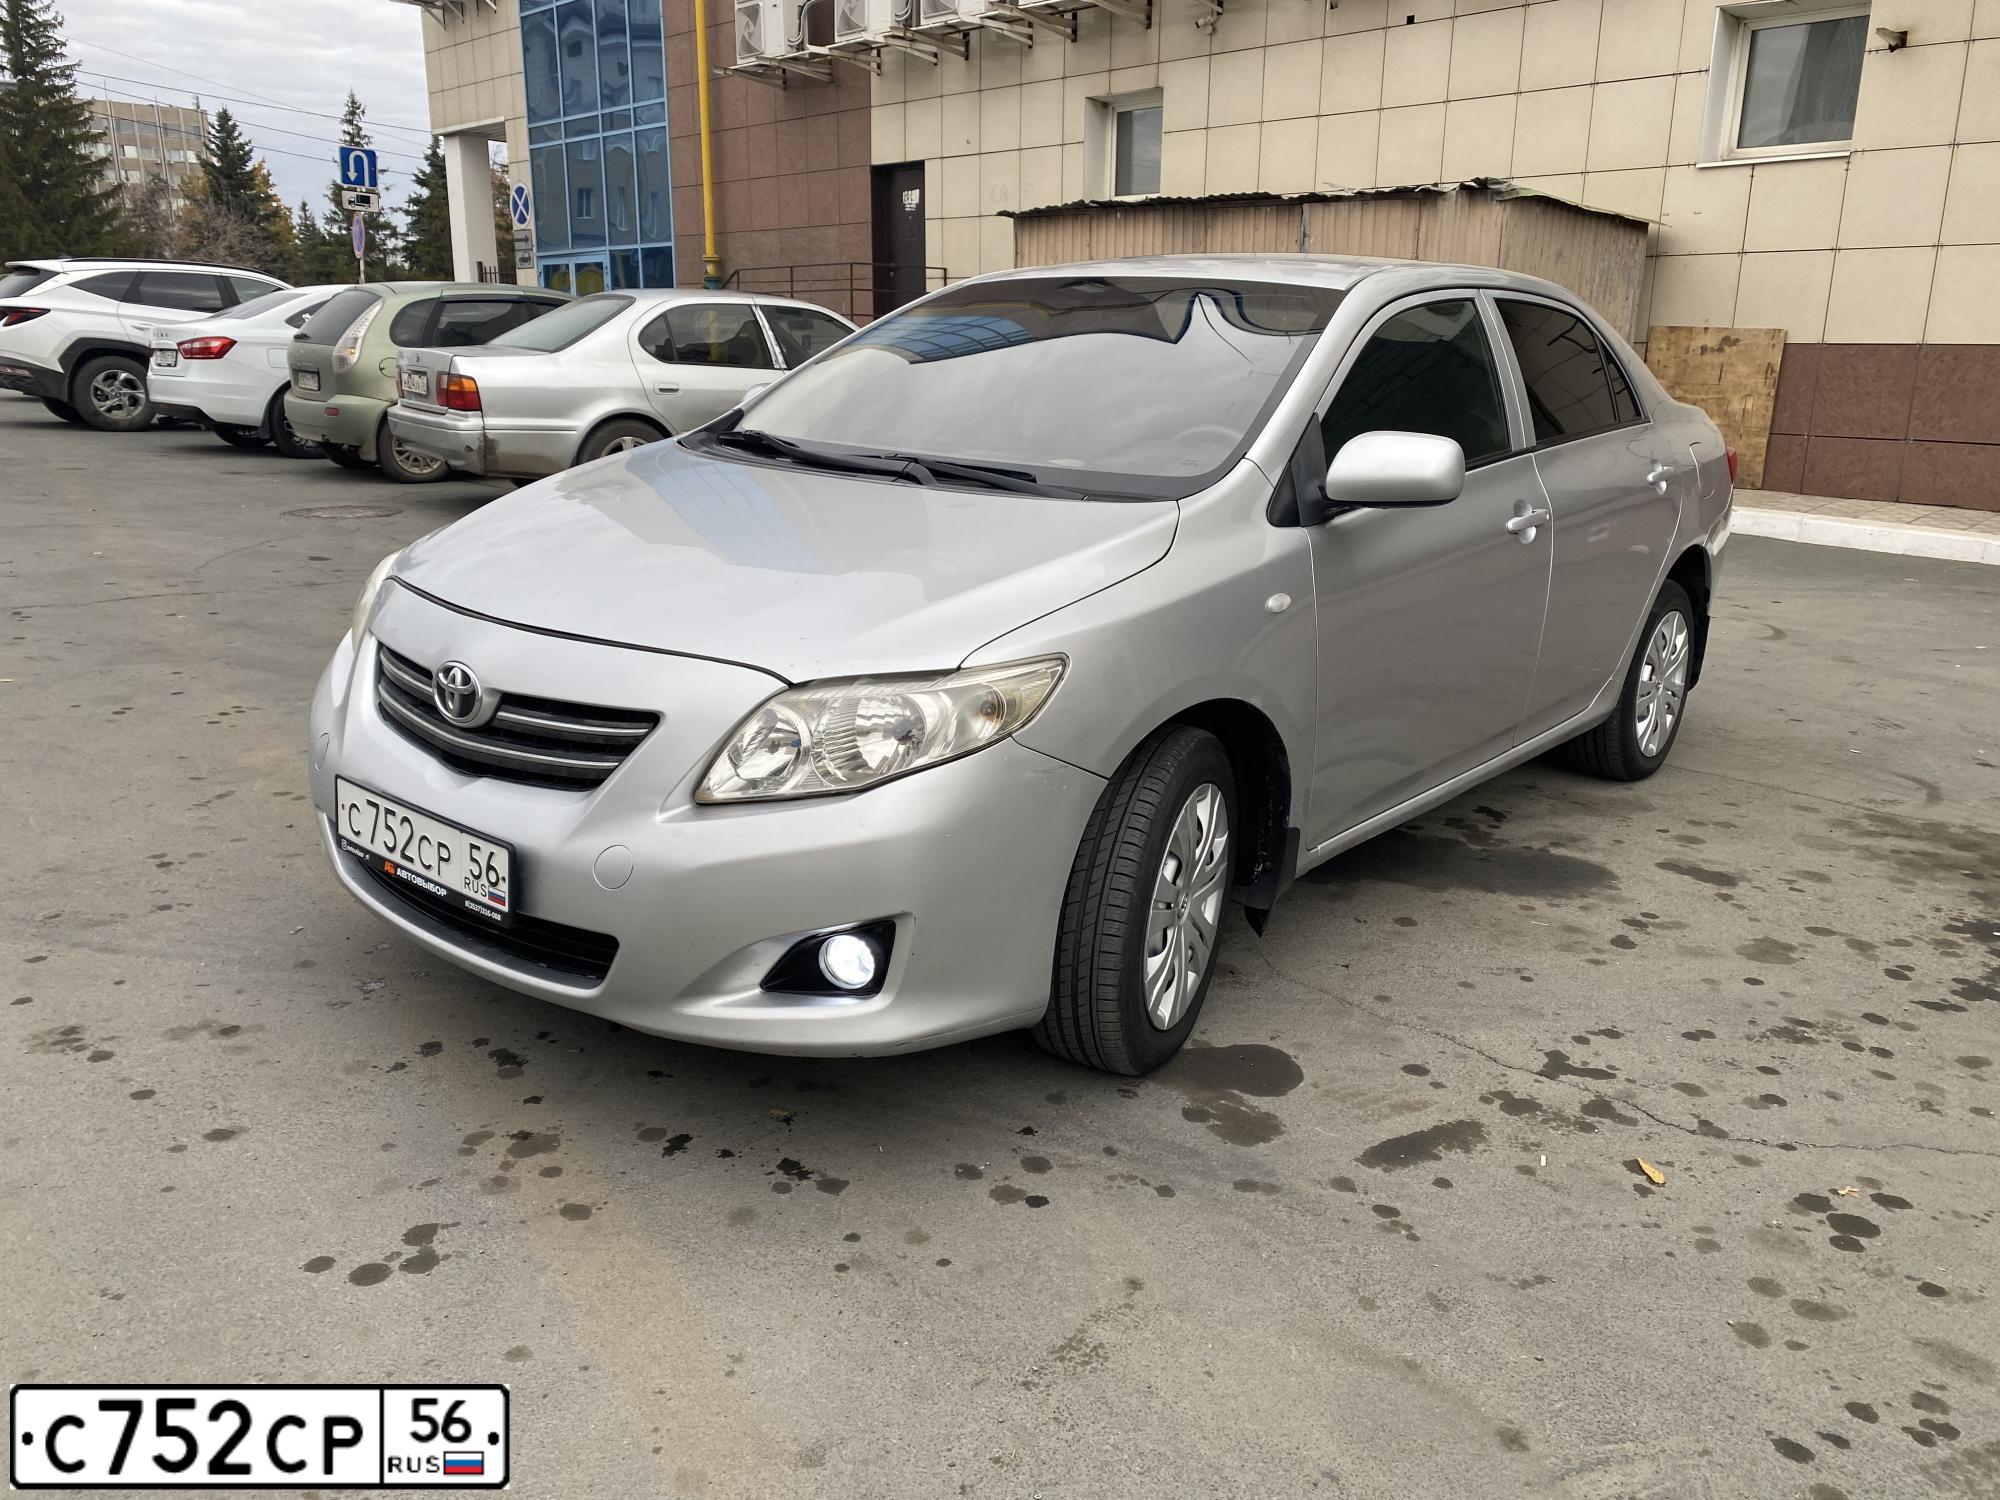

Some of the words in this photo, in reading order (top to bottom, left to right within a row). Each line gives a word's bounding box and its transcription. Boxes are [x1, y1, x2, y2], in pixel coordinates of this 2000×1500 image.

[348, 799, 451, 876] С752СР
[469, 842, 500, 887] 56
[396, 867, 447, 897] АВТОВЫБОР
[464, 876, 487, 898] RUS
